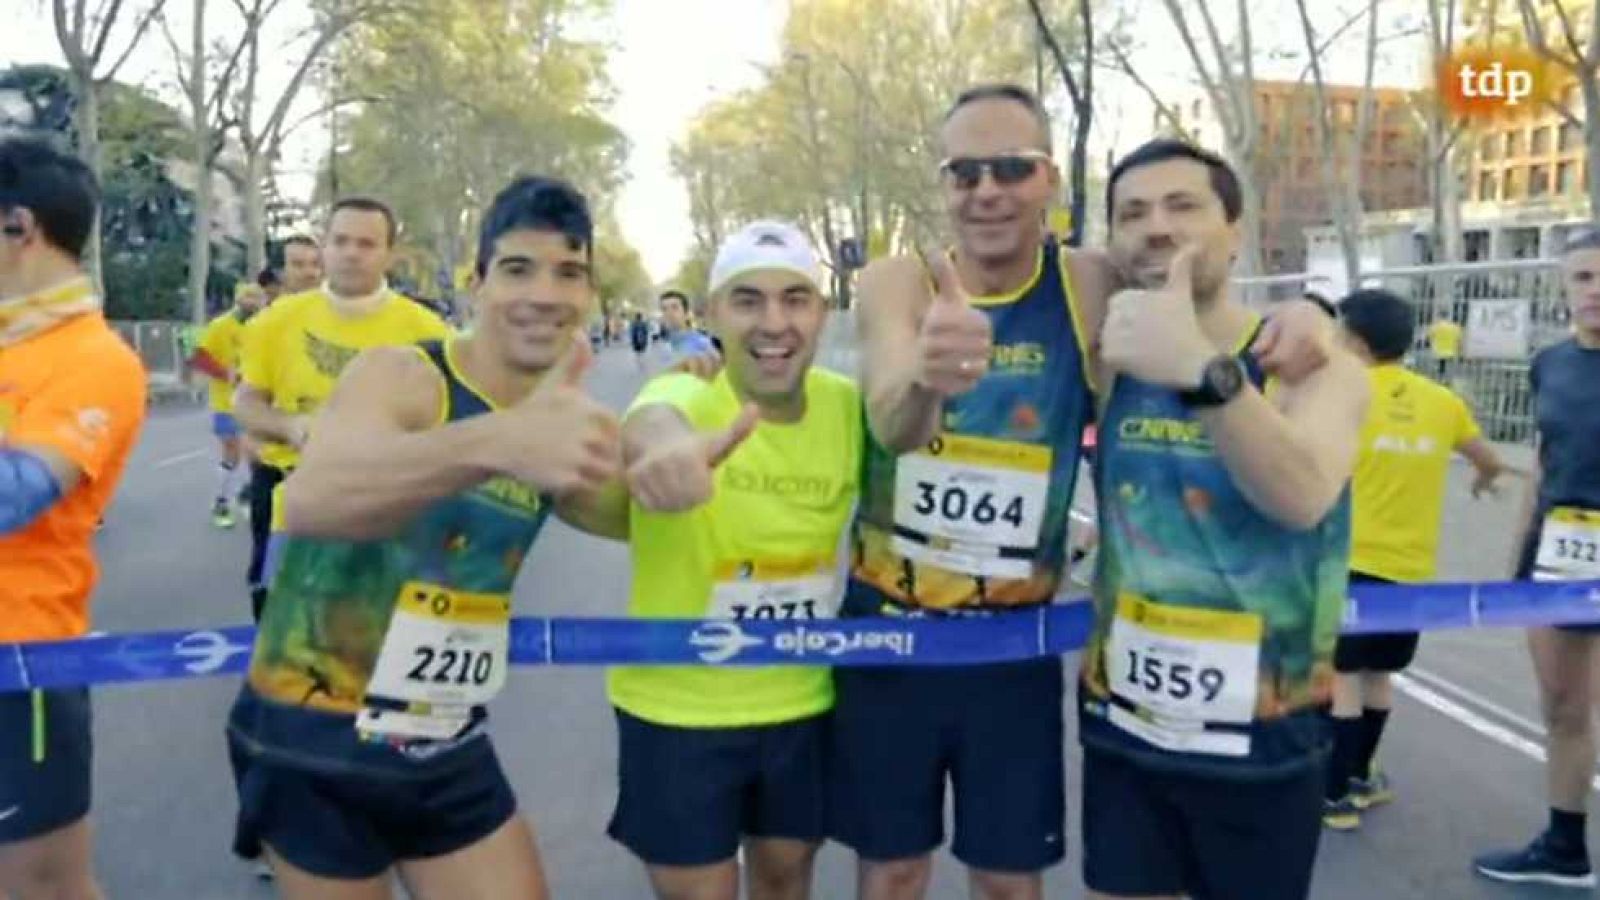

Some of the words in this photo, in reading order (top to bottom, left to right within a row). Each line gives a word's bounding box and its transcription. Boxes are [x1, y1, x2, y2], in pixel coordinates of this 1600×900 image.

[913, 480, 1024, 528] 3064
[405, 644, 494, 687] 2210
[1126, 648, 1226, 703] 1559
